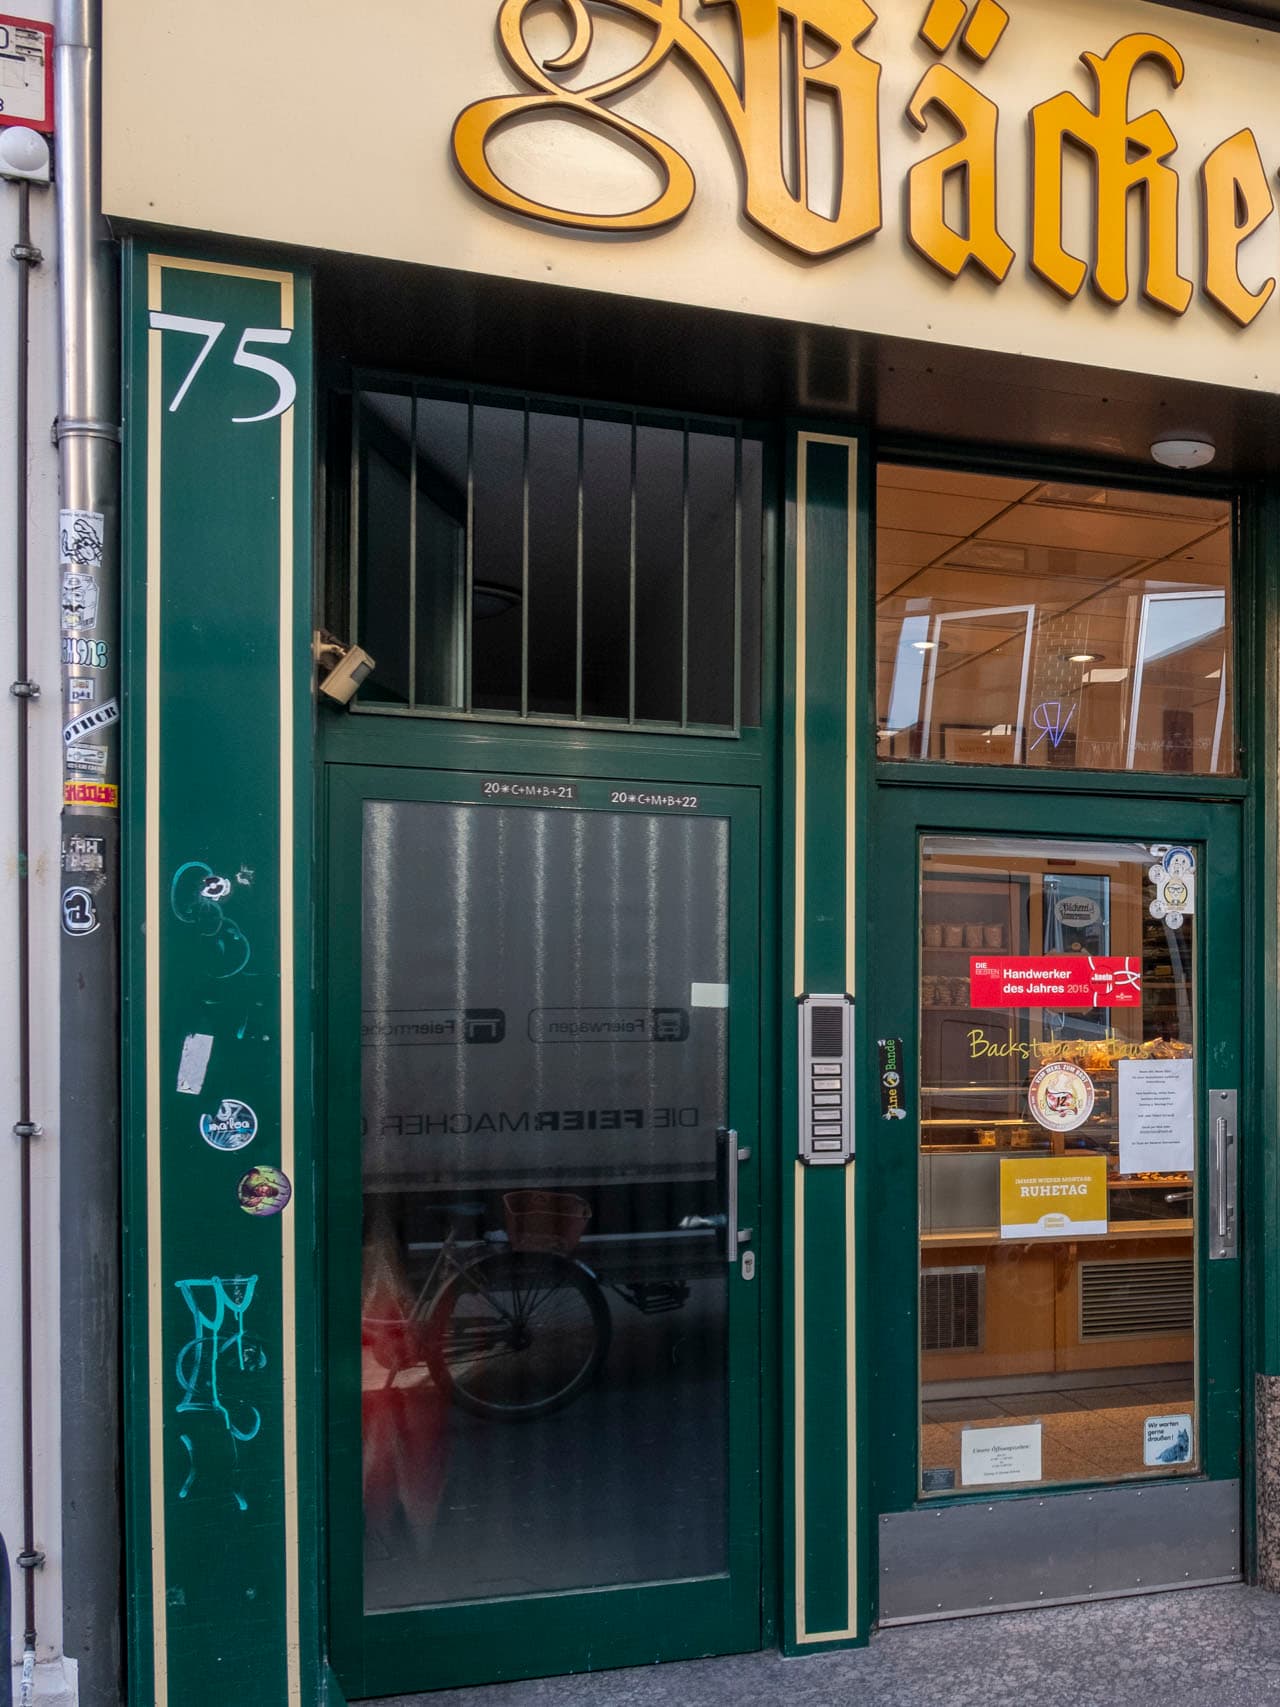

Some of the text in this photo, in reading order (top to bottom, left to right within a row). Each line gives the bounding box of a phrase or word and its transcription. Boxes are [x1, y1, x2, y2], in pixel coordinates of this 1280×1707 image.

[149, 311, 297, 423] 75
[1003, 968, 1072, 979] Handwerker
[1003, 983, 1089, 994] des Jahres 2015
[885, 1038, 896, 1071] Bande
[1020, 1184, 1088, 1197] RUHETAG
